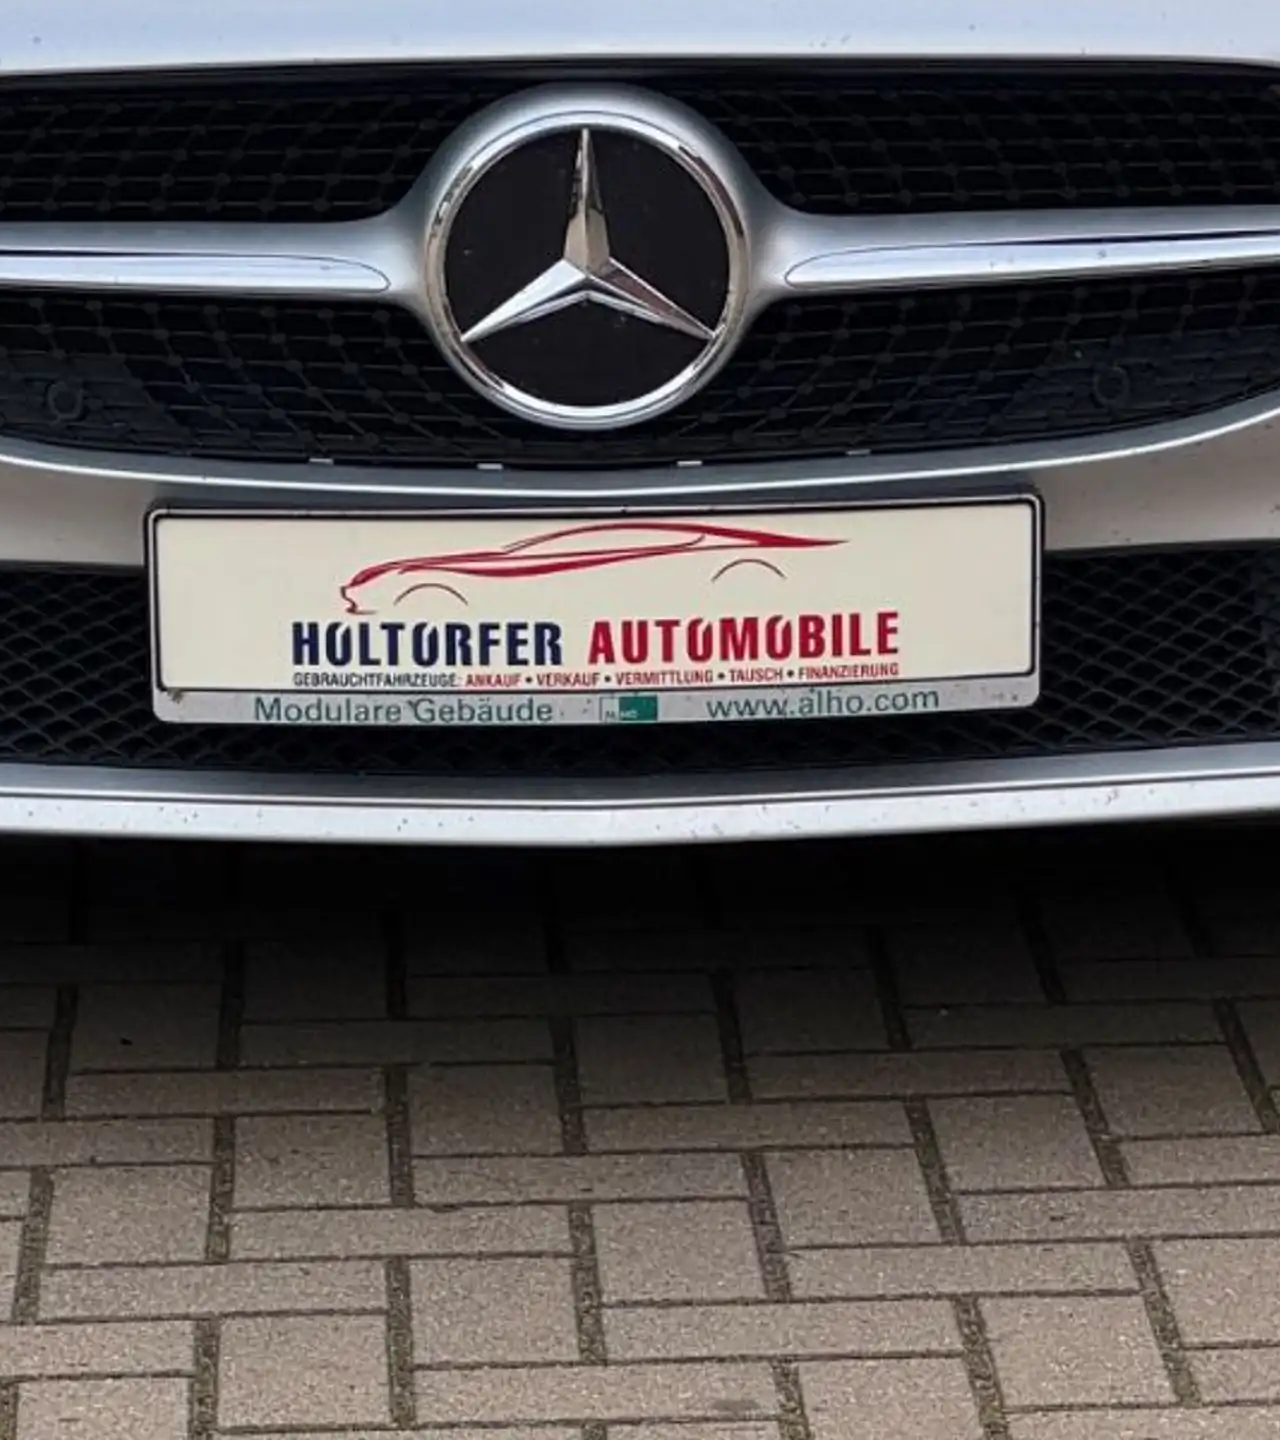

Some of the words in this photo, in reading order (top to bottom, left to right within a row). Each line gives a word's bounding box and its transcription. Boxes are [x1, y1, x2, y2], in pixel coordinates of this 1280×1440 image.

[291, 621, 564, 667] HOLTORFER
[588, 611, 900, 666] AUTOMOBILE
[465, 672, 522, 688] ANKAUF
[536, 670, 600, 688] VERKAUF
[615, 667, 714, 686] VERMITTLUNG
[728, 666, 784, 683] TAUSCH
[798, 661, 900, 681] FINANZIERUNG
[254, 696, 402, 723] Modulare
[413, 695, 554, 724] Gebäude
[705, 688, 940, 719] www.alho.com
